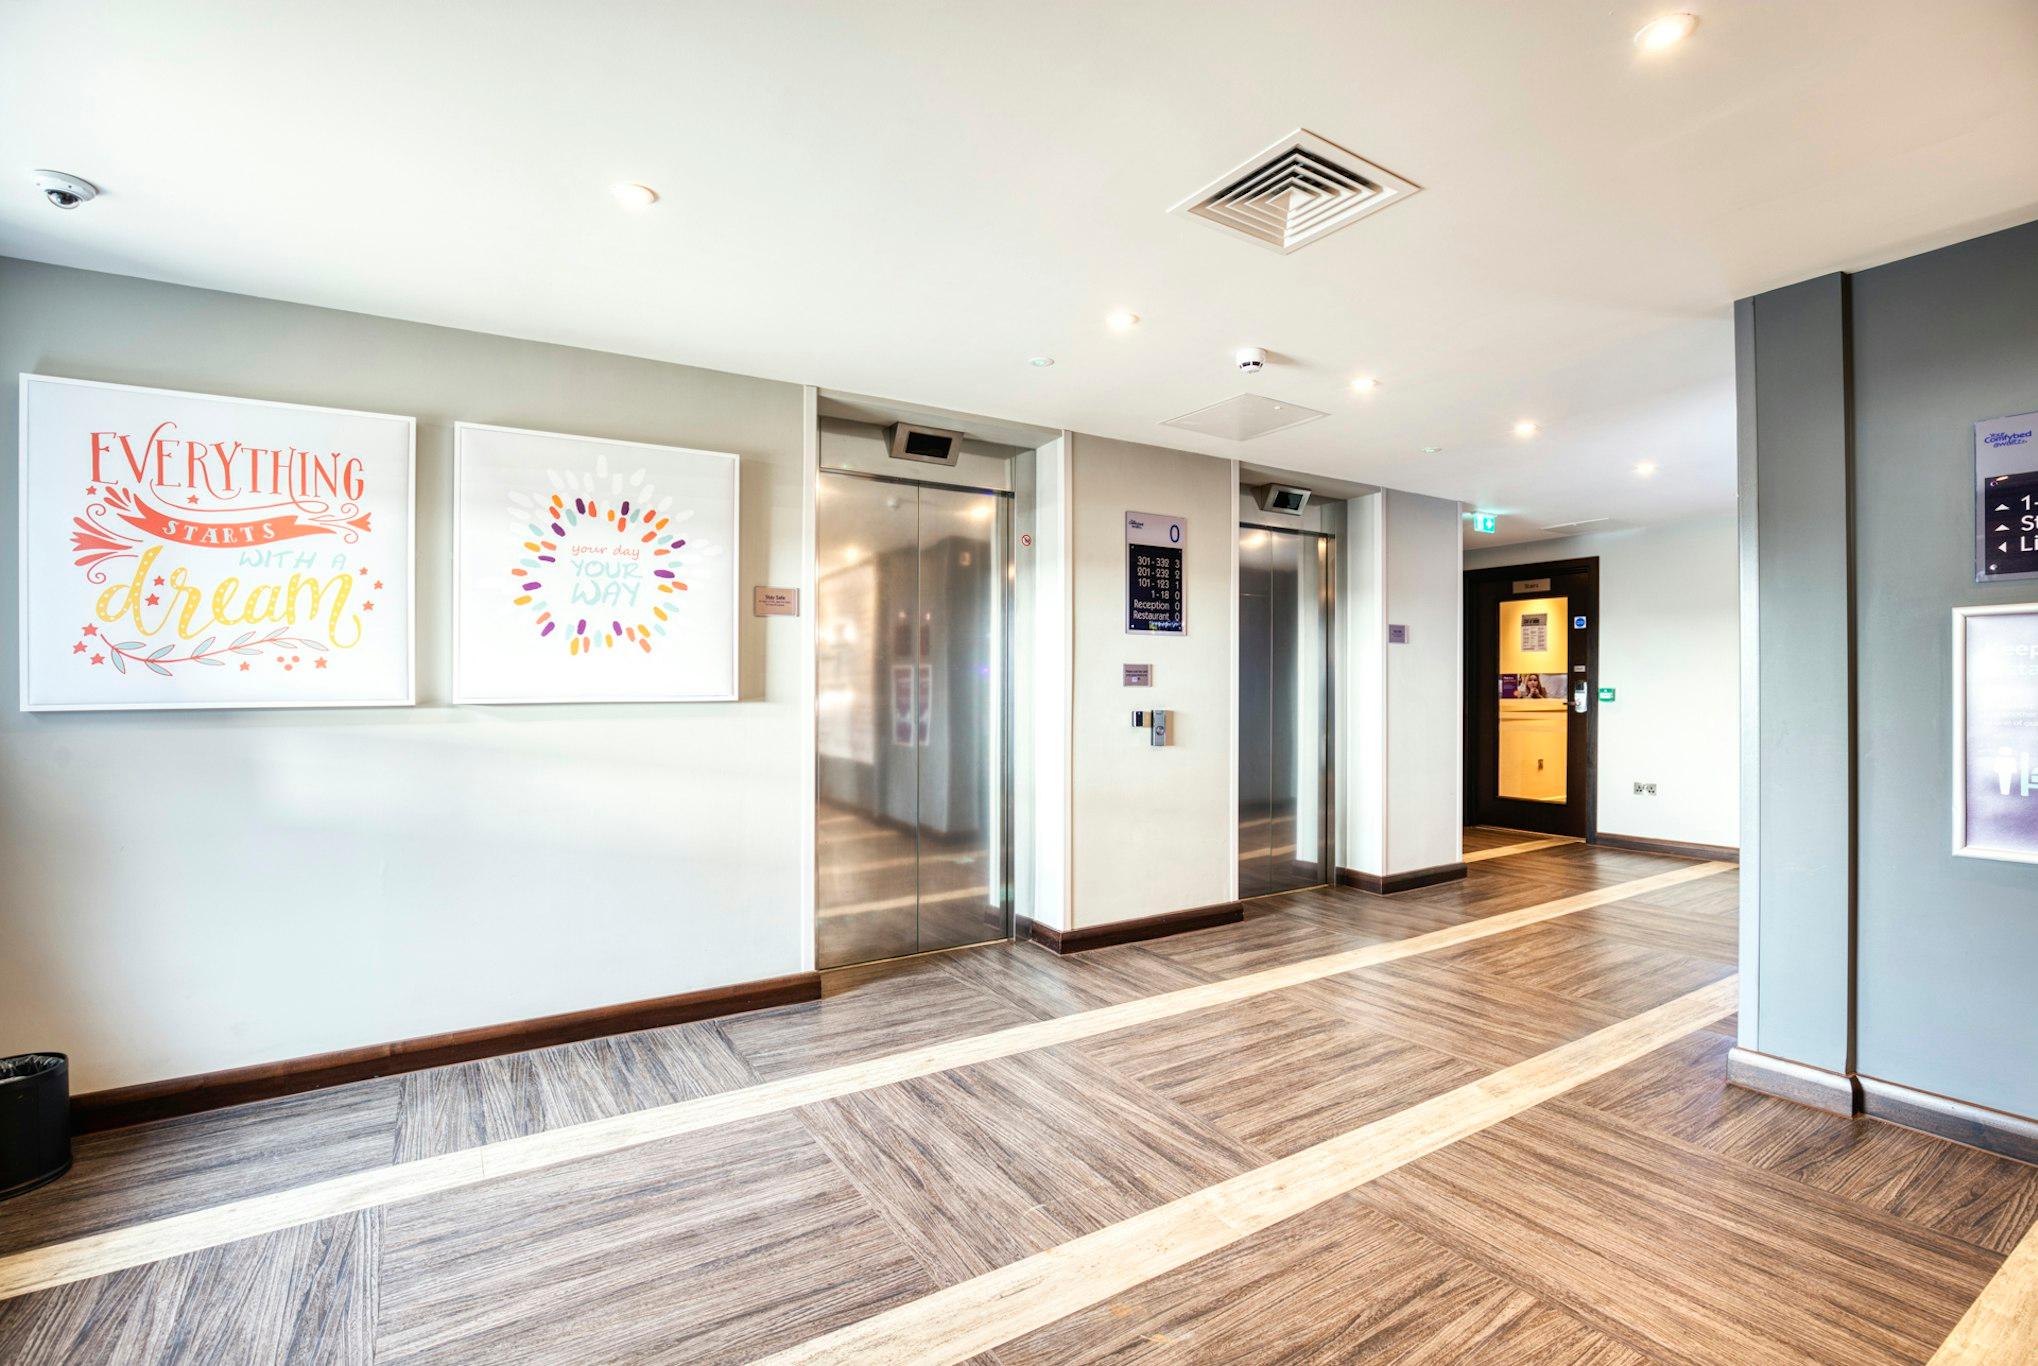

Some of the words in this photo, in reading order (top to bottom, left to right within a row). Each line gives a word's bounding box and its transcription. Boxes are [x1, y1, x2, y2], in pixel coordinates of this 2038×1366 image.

[90, 421, 365, 512] EVERYTHING
[161, 520, 276, 545] STARTS
[239, 548, 318, 569] WITH
[331, 553, 347, 570] A
[571, 545, 608, 557] your
[612, 544, 640, 560] day
[570, 559, 643, 579] YOUR
[96, 545, 361, 649] dream
[571, 579, 641, 607] WAY
[1132, 610, 1170, 621] Restaurant
[1133, 599, 1170, 611] Reception
